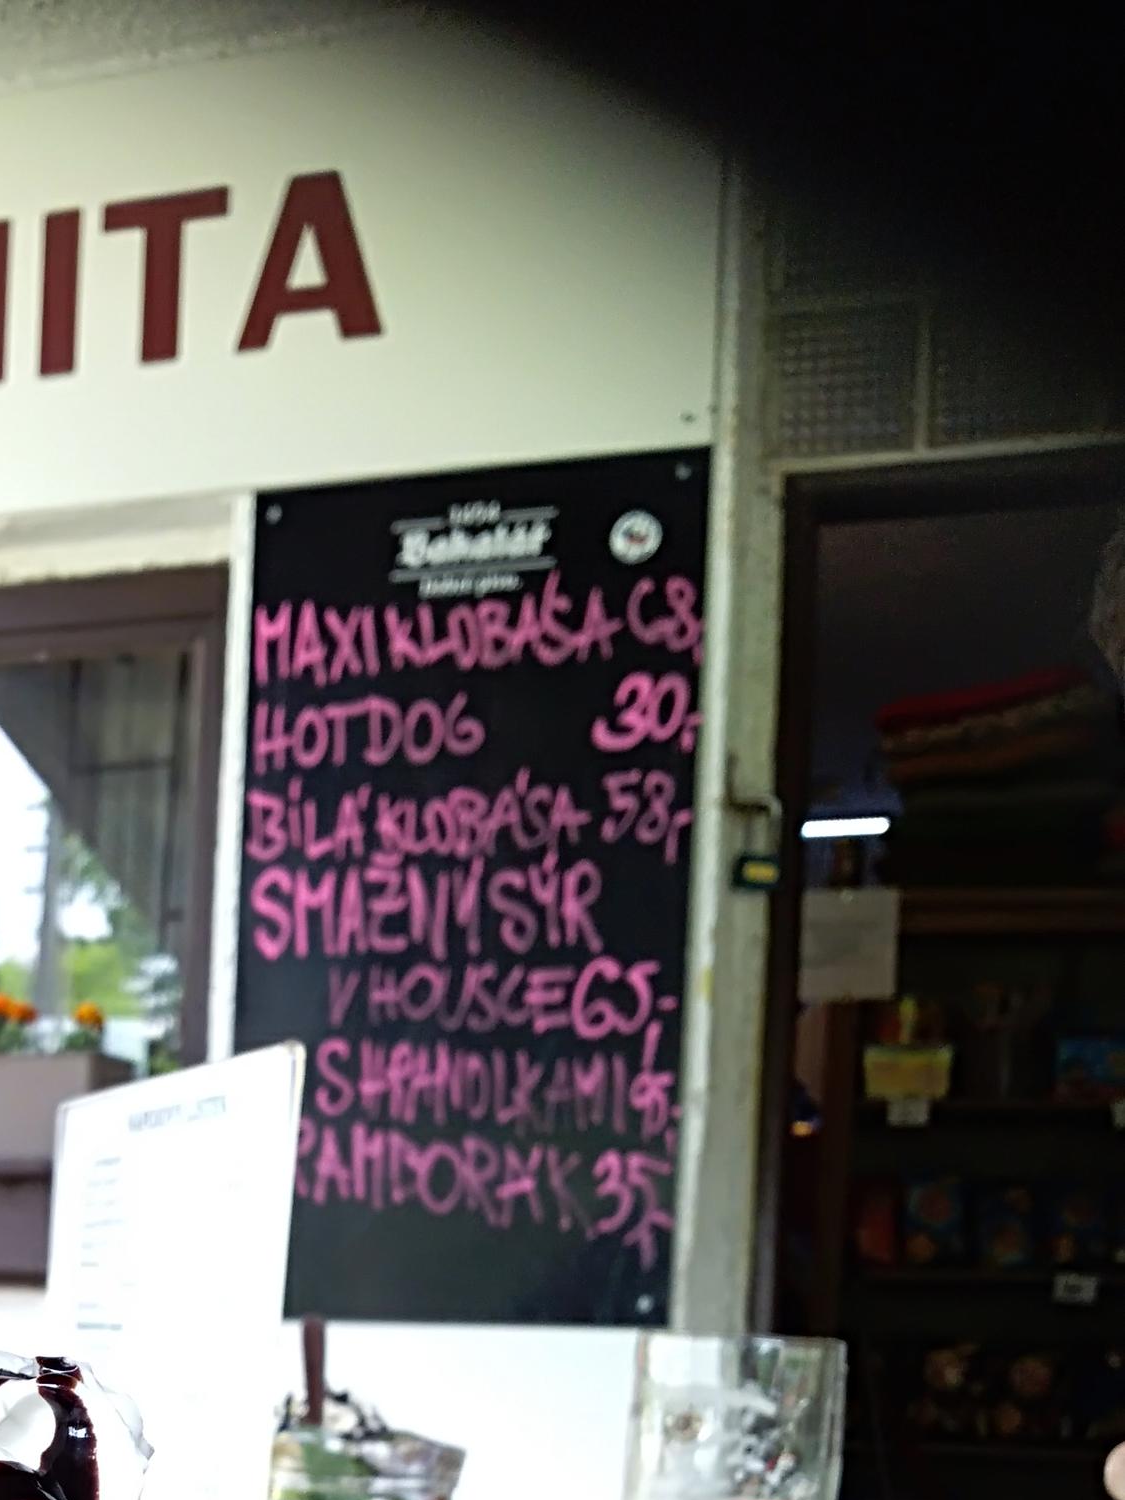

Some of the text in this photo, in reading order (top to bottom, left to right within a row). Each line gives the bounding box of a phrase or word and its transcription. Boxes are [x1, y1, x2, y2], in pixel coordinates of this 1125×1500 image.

[252, 599, 379, 688] MAXI
[247, 776, 373, 861] BÍLÁ
[486, 849, 604, 955] SÝR
[327, 966, 359, 1028] V
[315, 1038, 354, 1117] S
